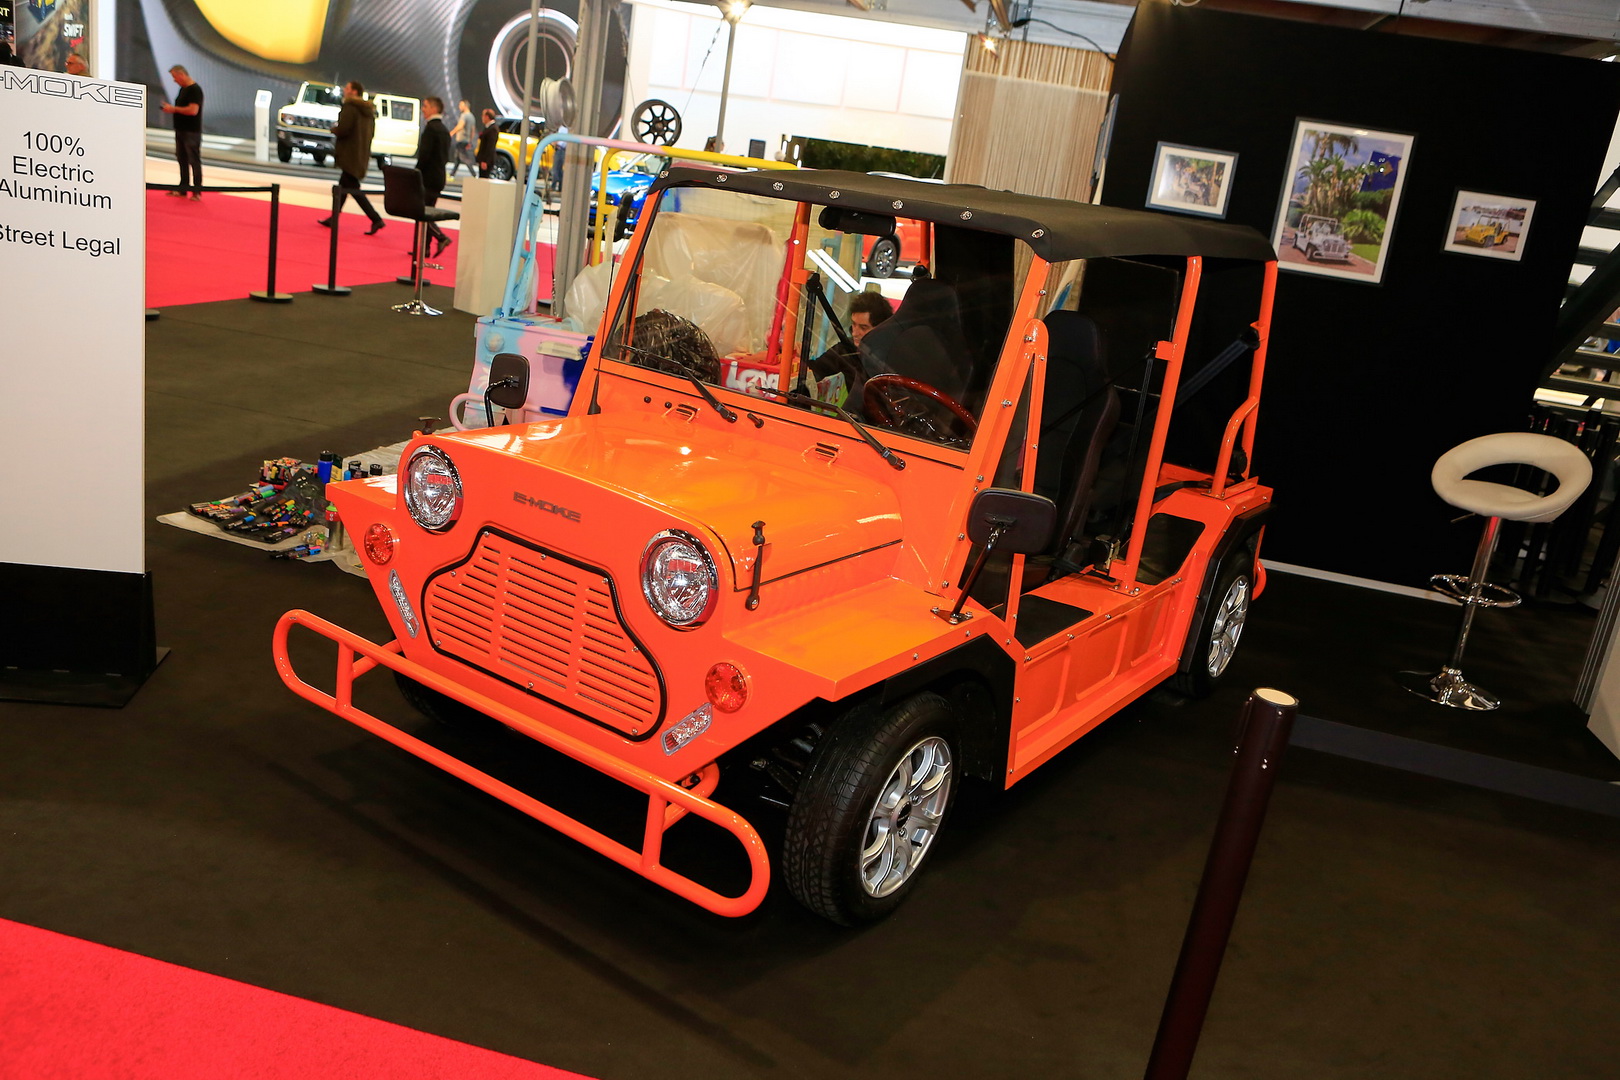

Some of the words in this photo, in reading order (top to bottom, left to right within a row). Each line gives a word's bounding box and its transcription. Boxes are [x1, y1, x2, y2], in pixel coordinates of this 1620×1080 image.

[23, 131, 85, 157] 100%
[13, 155, 94, 184] Electric
[0, 179, 111, 209] Aluminium
[62, 231, 120, 257] Legal
[513, 491, 582, 523] E-MOKE
